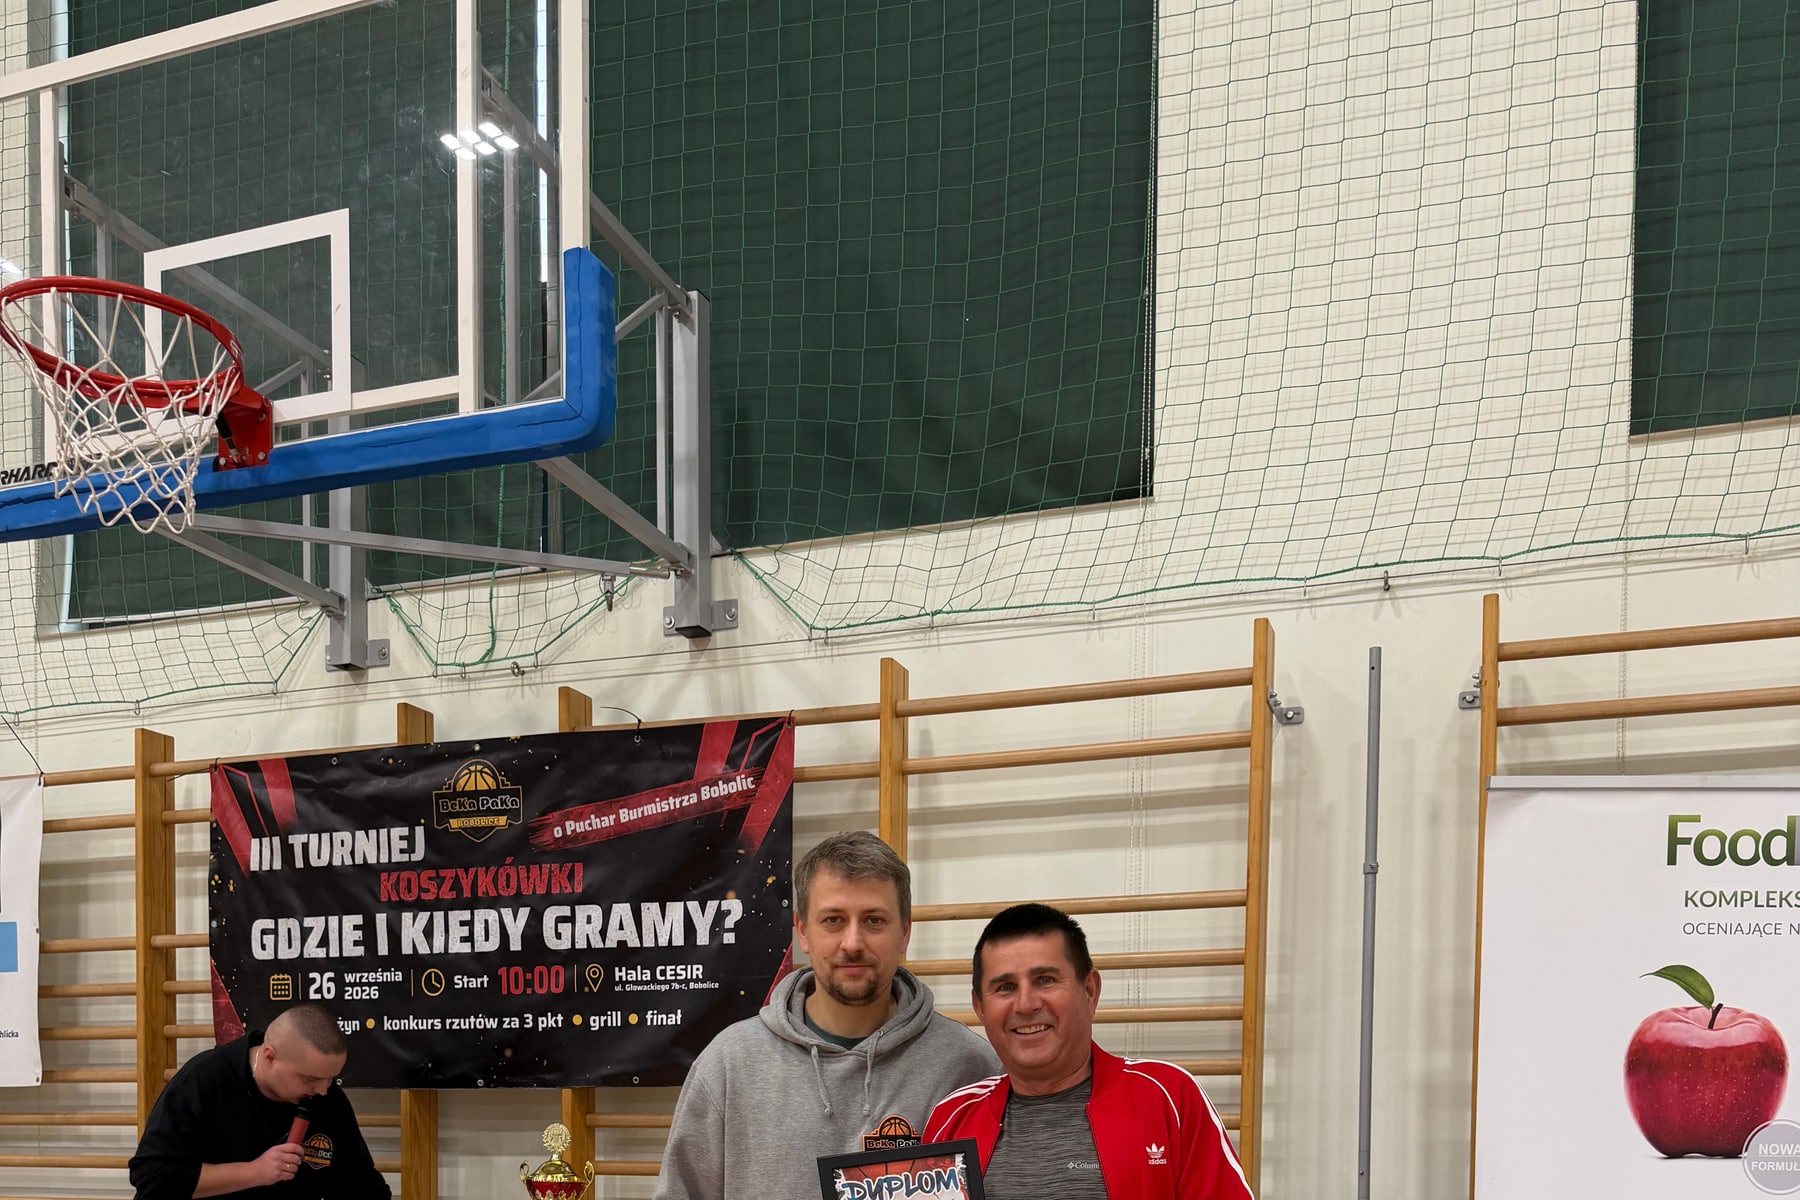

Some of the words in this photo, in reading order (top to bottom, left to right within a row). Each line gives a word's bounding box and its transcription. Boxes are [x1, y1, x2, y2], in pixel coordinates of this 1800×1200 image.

[439, 797, 477, 812] BeKa
[479, 795, 520, 810] PaKa
[553, 826, 563, 839] o
[564, 813, 616, 836] Puchar
[619, 791, 698, 823] Burmistrza
[700, 774, 756, 801] Bobolic
[250, 836, 282, 871] III
[288, 826, 425, 869] TURNIEJ
[1667, 814, 1800, 867] Food
[379, 857, 584, 902] KOSZYKÓWKI
[251, 914, 365, 961] GDZIE
[375, 913, 389, 956] I
[401, 906, 531, 955] KIEDY
[542, 899, 743, 951] GRAMY?
[1682, 922, 1782, 937] OCENIAJĄCE
[344, 968, 402, 983] września
[453, 975, 489, 989] Start
[497, 966, 565, 995] 10:00
[614, 965, 651, 981] Hala
[655, 964, 703, 980] CESIR
[308, 971, 336, 1000] 26
[344, 986, 379, 1000] 2026
[689, 981, 719, 989] Bobolice
[383, 1014, 442, 1031] konkurs
[445, 1014, 499, 1030] rzutów
[502, 1017, 520, 1029] za
[523, 1013, 533, 1029] 3
[538, 1011, 564, 1031] pkt
[589, 1010, 622, 1031] grill
[645, 1009, 682, 1027] finał
[1759, 1143, 1800, 1155] NOWA
